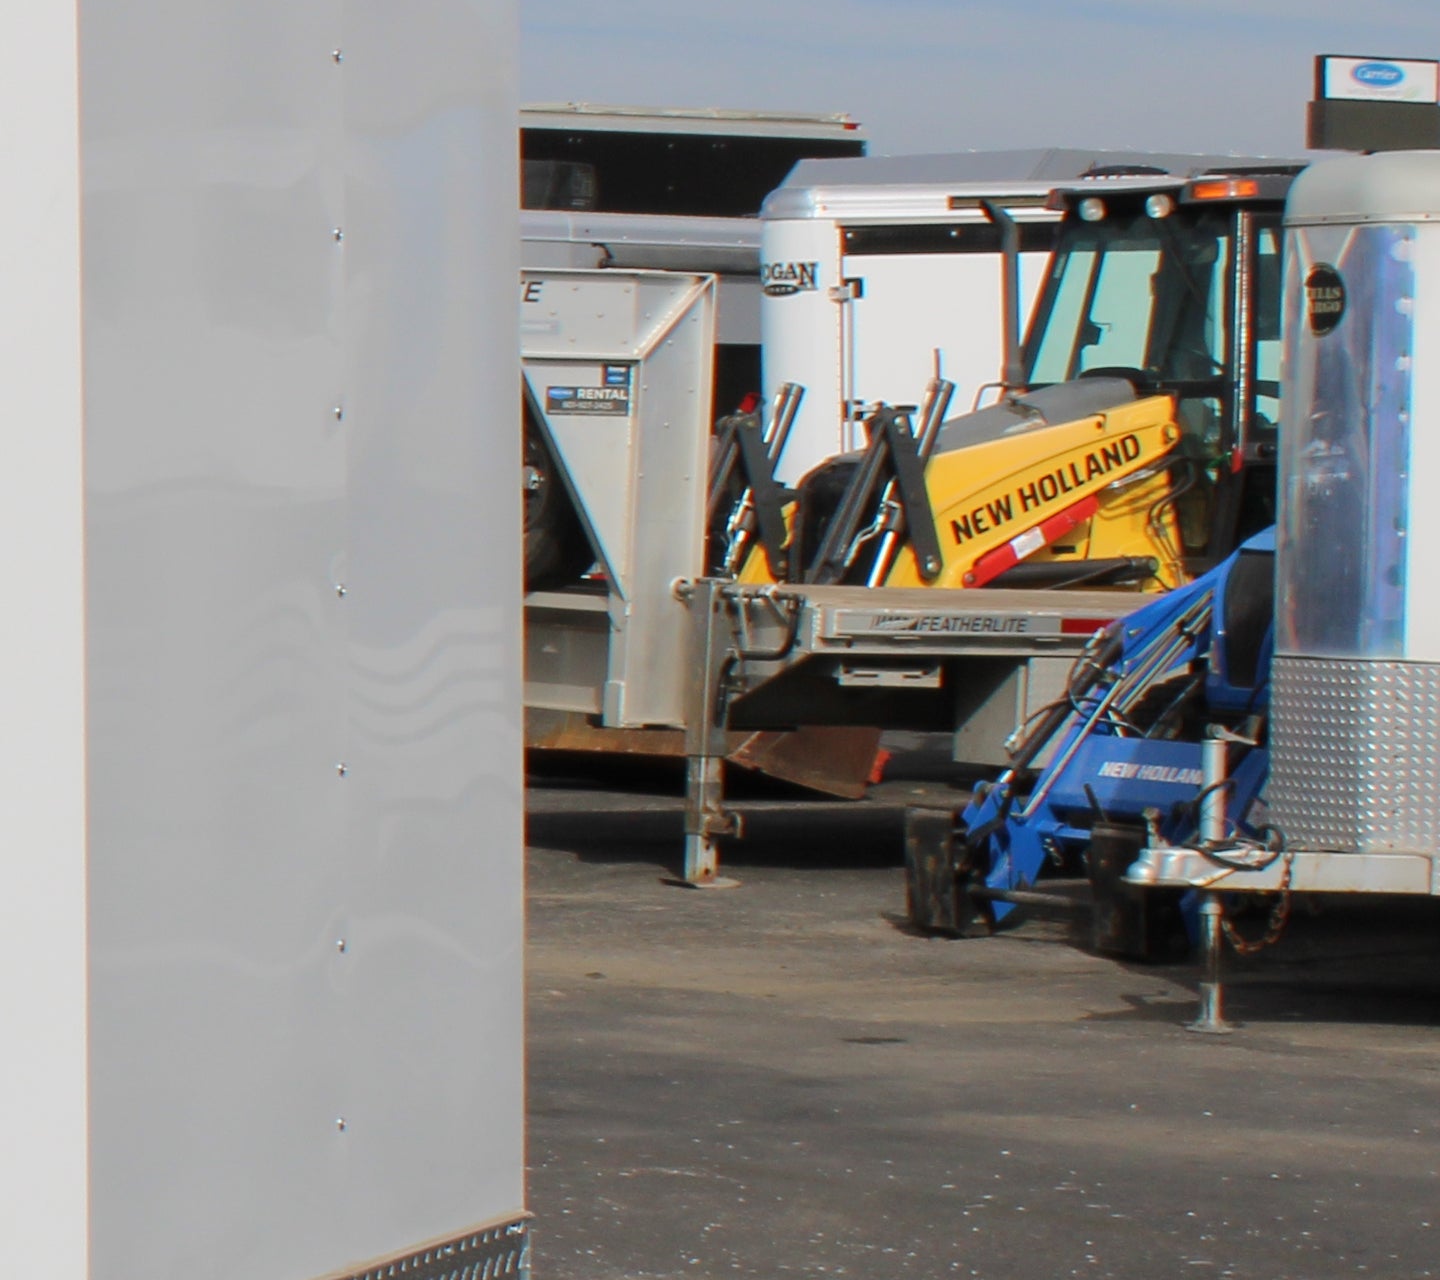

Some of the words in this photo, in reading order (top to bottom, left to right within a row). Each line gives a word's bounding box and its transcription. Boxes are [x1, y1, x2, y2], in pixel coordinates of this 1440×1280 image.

[576, 388, 629, 400] RENTAL
[950, 494, 1013, 545] NEW
[1017, 433, 1141, 513] HOLLAND
[918, 615, 1029, 633] FEATHERLITE
[1097, 761, 1141, 779] NEW
